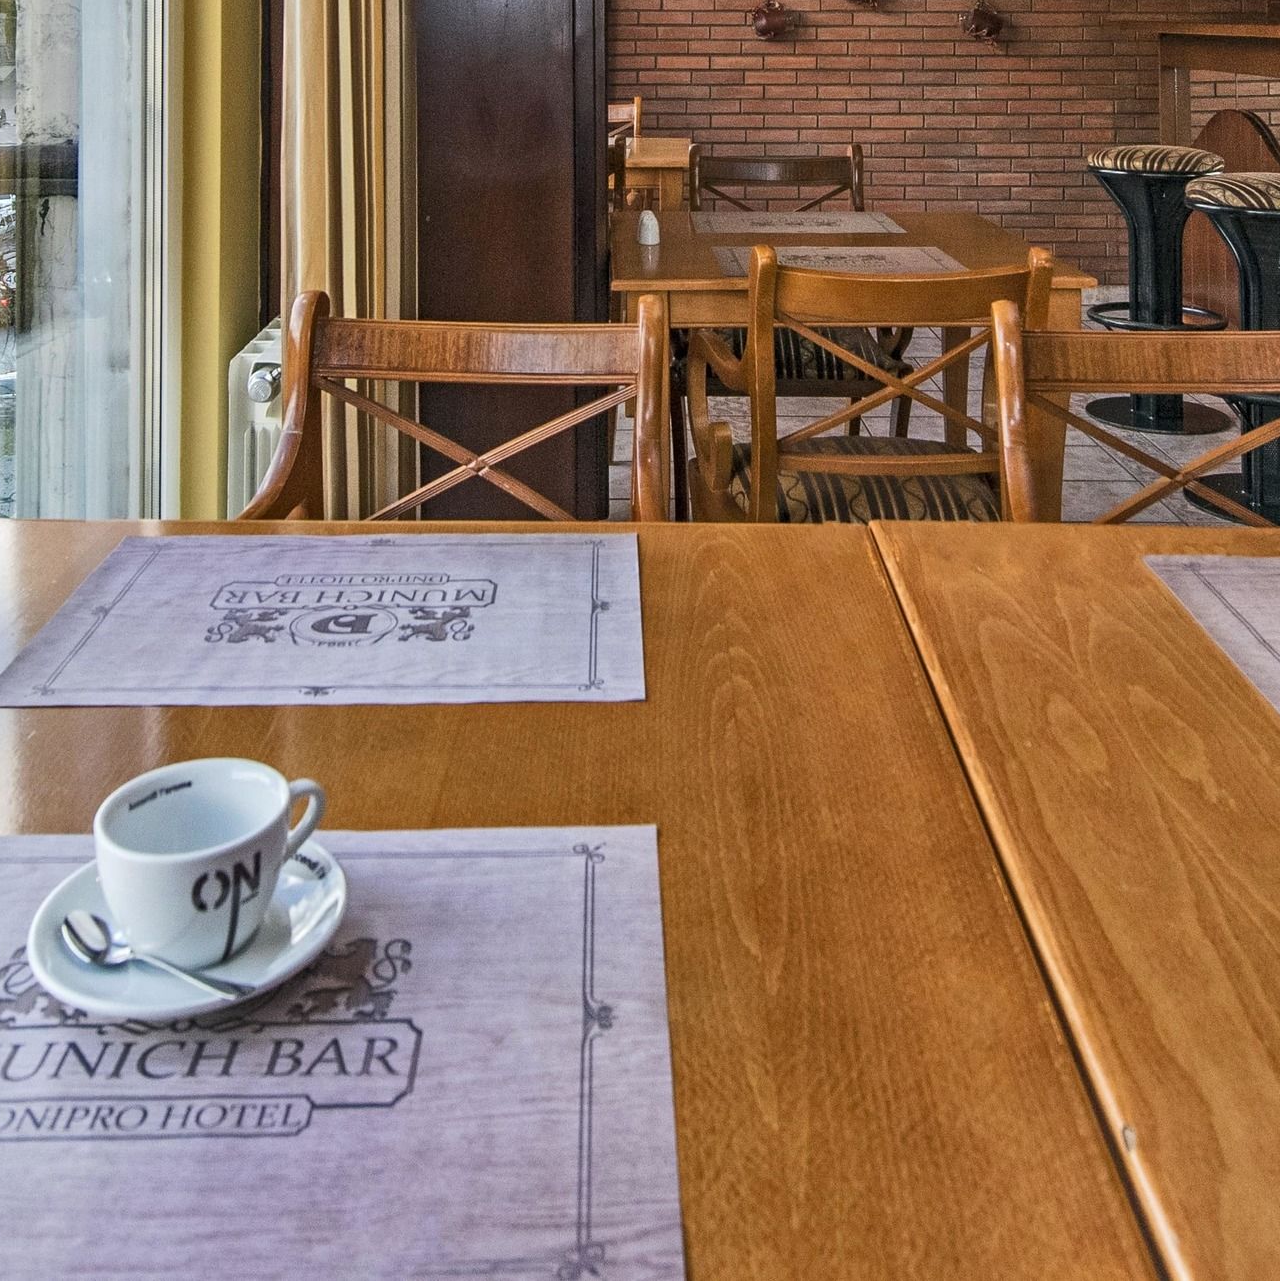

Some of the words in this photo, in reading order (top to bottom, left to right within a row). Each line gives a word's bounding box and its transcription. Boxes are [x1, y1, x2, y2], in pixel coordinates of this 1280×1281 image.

[224, 589, 302, 605] BAR
[316, 589, 488, 604] MUNICH
[263, 1037, 400, 1078] BAR
[159, 1102, 305, 1131] HOTEL
